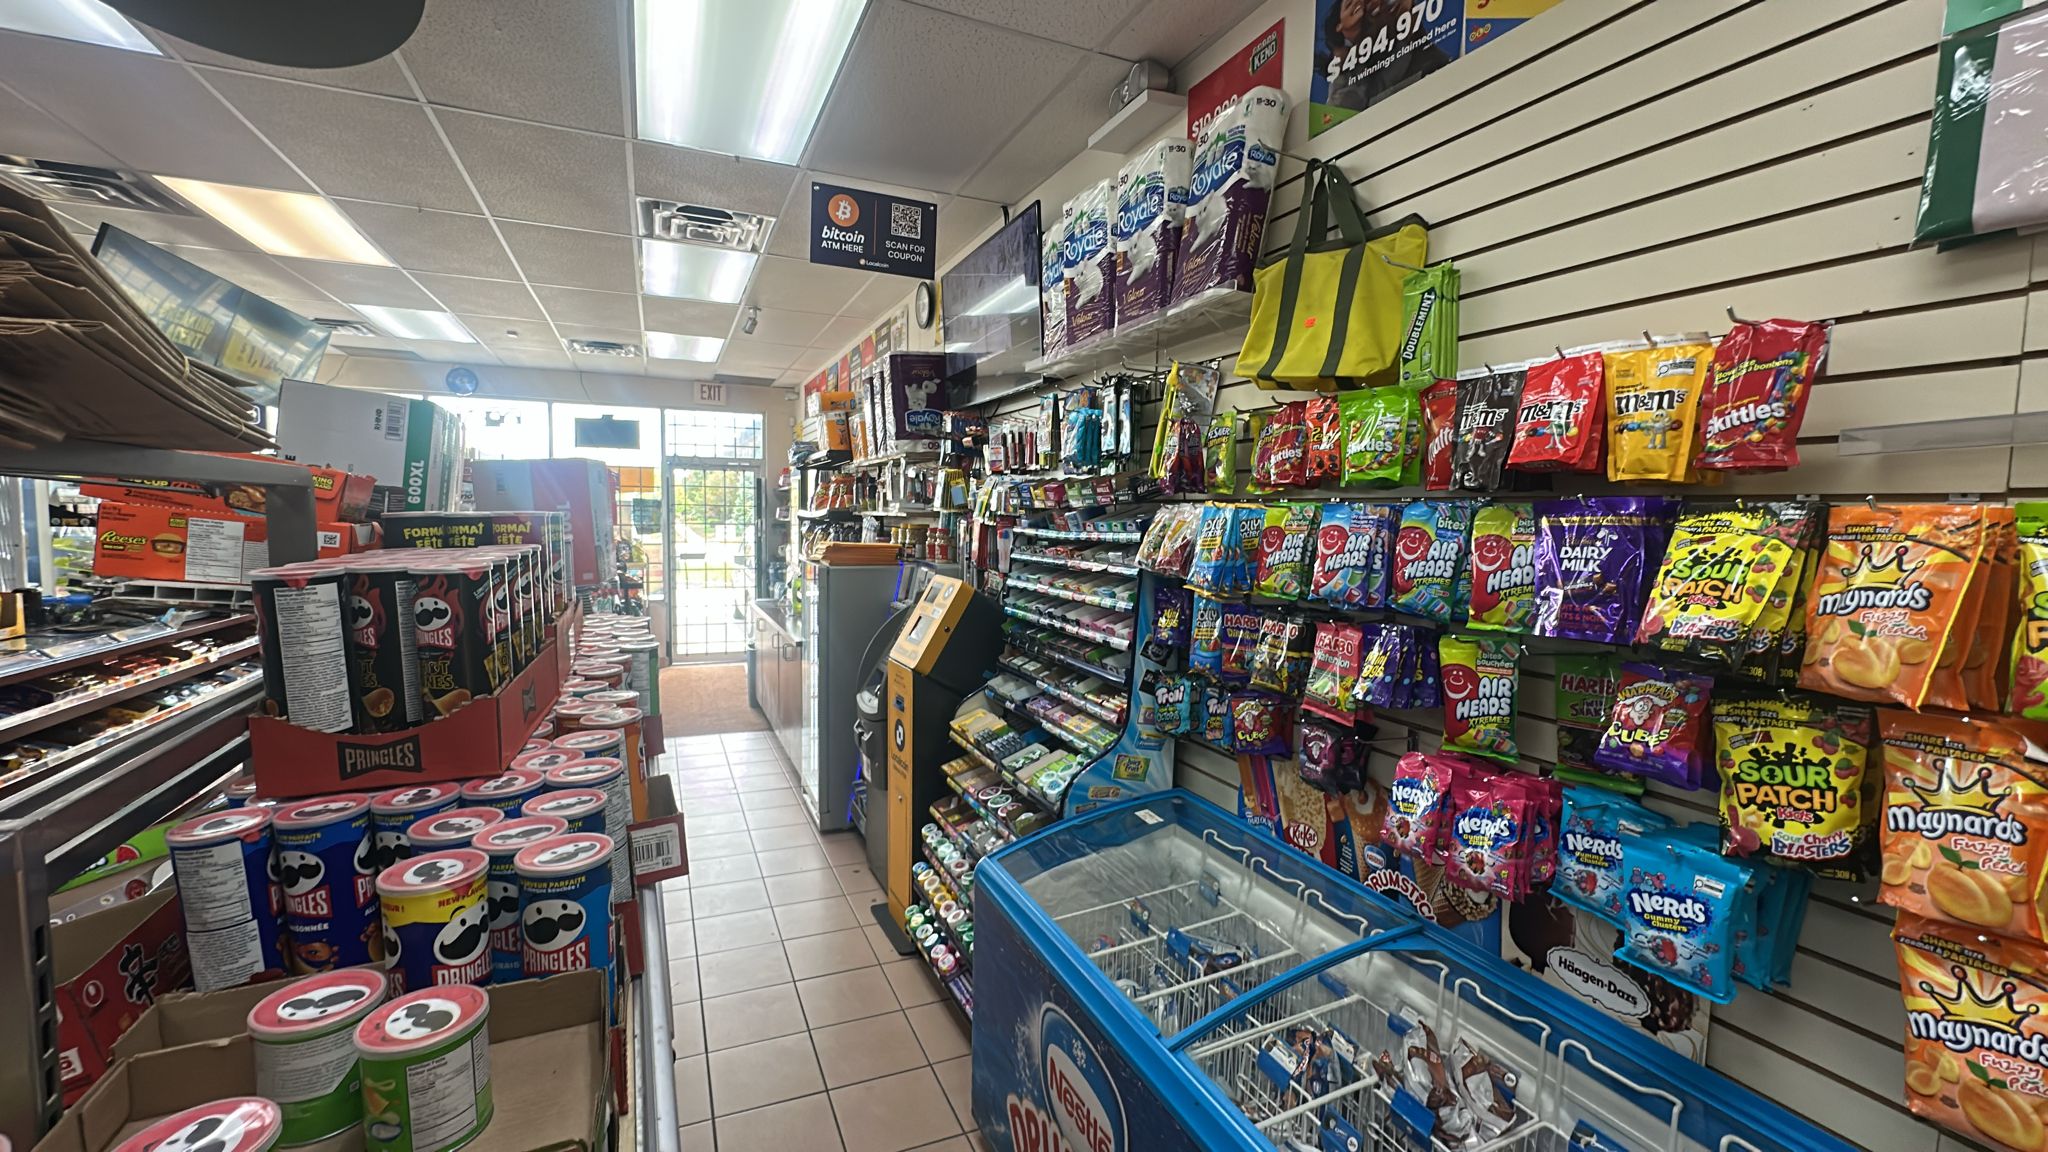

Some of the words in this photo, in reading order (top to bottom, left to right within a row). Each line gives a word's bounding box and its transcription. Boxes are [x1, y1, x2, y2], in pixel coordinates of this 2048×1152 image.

[1327, 0, 1443, 83] $494,970
[1254, 42, 1277, 70] KENO
[1348, 75, 1357, 86] in
[1357, 55, 1395, 81] winnings
[1396, 30, 1434, 58] claimed
[1434, 18, 1457, 38] here
[1189, 151, 1238, 200] Royale
[1118, 194, 1160, 234] Royale
[822, 226, 865, 243] bitcoin
[821, 241, 840, 251] ATM
[842, 243, 864, 254] HERE
[885, 240, 908, 251] SCAN
[910, 244, 926, 254] FOR
[1063, 229, 1104, 261] Royale
[887, 251, 923, 263] COUPON
[1402, 291, 1436, 360] DOUBLEMINT
[700, 384, 722, 401] EXIT
[909, 413, 941, 425] Royale
[407, 458, 425, 504] 600XL
[1437, 517, 1465, 531] bites
[100, 530, 148, 545] Reese's
[1282, 533, 1305, 550] AIR
[1344, 534, 1372, 553] AIR
[1861, 533, 1906, 542] PARTAGER
[1266, 548, 1303, 568] HEADS
[1427, 540, 1459, 561] AIR
[1560, 546, 1613, 560] DAIRY
[1325, 550, 1368, 572] HEADS
[1406, 560, 1454, 580] HEADS
[1561, 559, 1602, 572] MILK
[1673, 560, 1750, 584] SOUR
[1413, 577, 1452, 587] XTREMES
[1663, 577, 1744, 604] PATCH
[1861, 609, 1909, 624] Fuzzy
[1877, 622, 1928, 641] Peach
[1477, 659, 1514, 668] bouchées
[1479, 677, 1512, 698] AIR
[1561, 672, 1616, 697] HARIB
[1155, 685, 1185, 705] Trolli
[1456, 697, 1511, 720] HEADS
[1469, 716, 1511, 728] XTREMES
[1748, 717, 1797, 730] PARTAGER
[1608, 721, 1671, 747] CUBES
[1906, 733, 1944, 746] SHARE
[1946, 740, 1964, 751] SIZE
[344, 742, 416, 773] PRINGLES
[1925, 744, 1986, 763] PARTAGER
[1738, 761, 1830, 790] SOUR
[1735, 783, 1836, 811] PATCH
[1776, 806, 1814, 823] Kids
[1290, 823, 1317, 848] KitKat
[1803, 830, 1843, 845] Cherry
[1772, 836, 1851, 858] BLASTERS
[1952, 837, 2011, 856] Fuzzy
[1979, 857, 2027, 876] Peach
[549, 875, 586, 888] PARFAITE
[437, 894, 460, 909] NEW
[1922, 934, 1962, 951] SHARE
[523, 940, 587, 974] PRINGLES
[1942, 948, 2008, 977] PARTAGER
[1558, 955, 1638, 1008] Häagen-Dazs
[1979, 1053, 2041, 1080] Fuzzy
